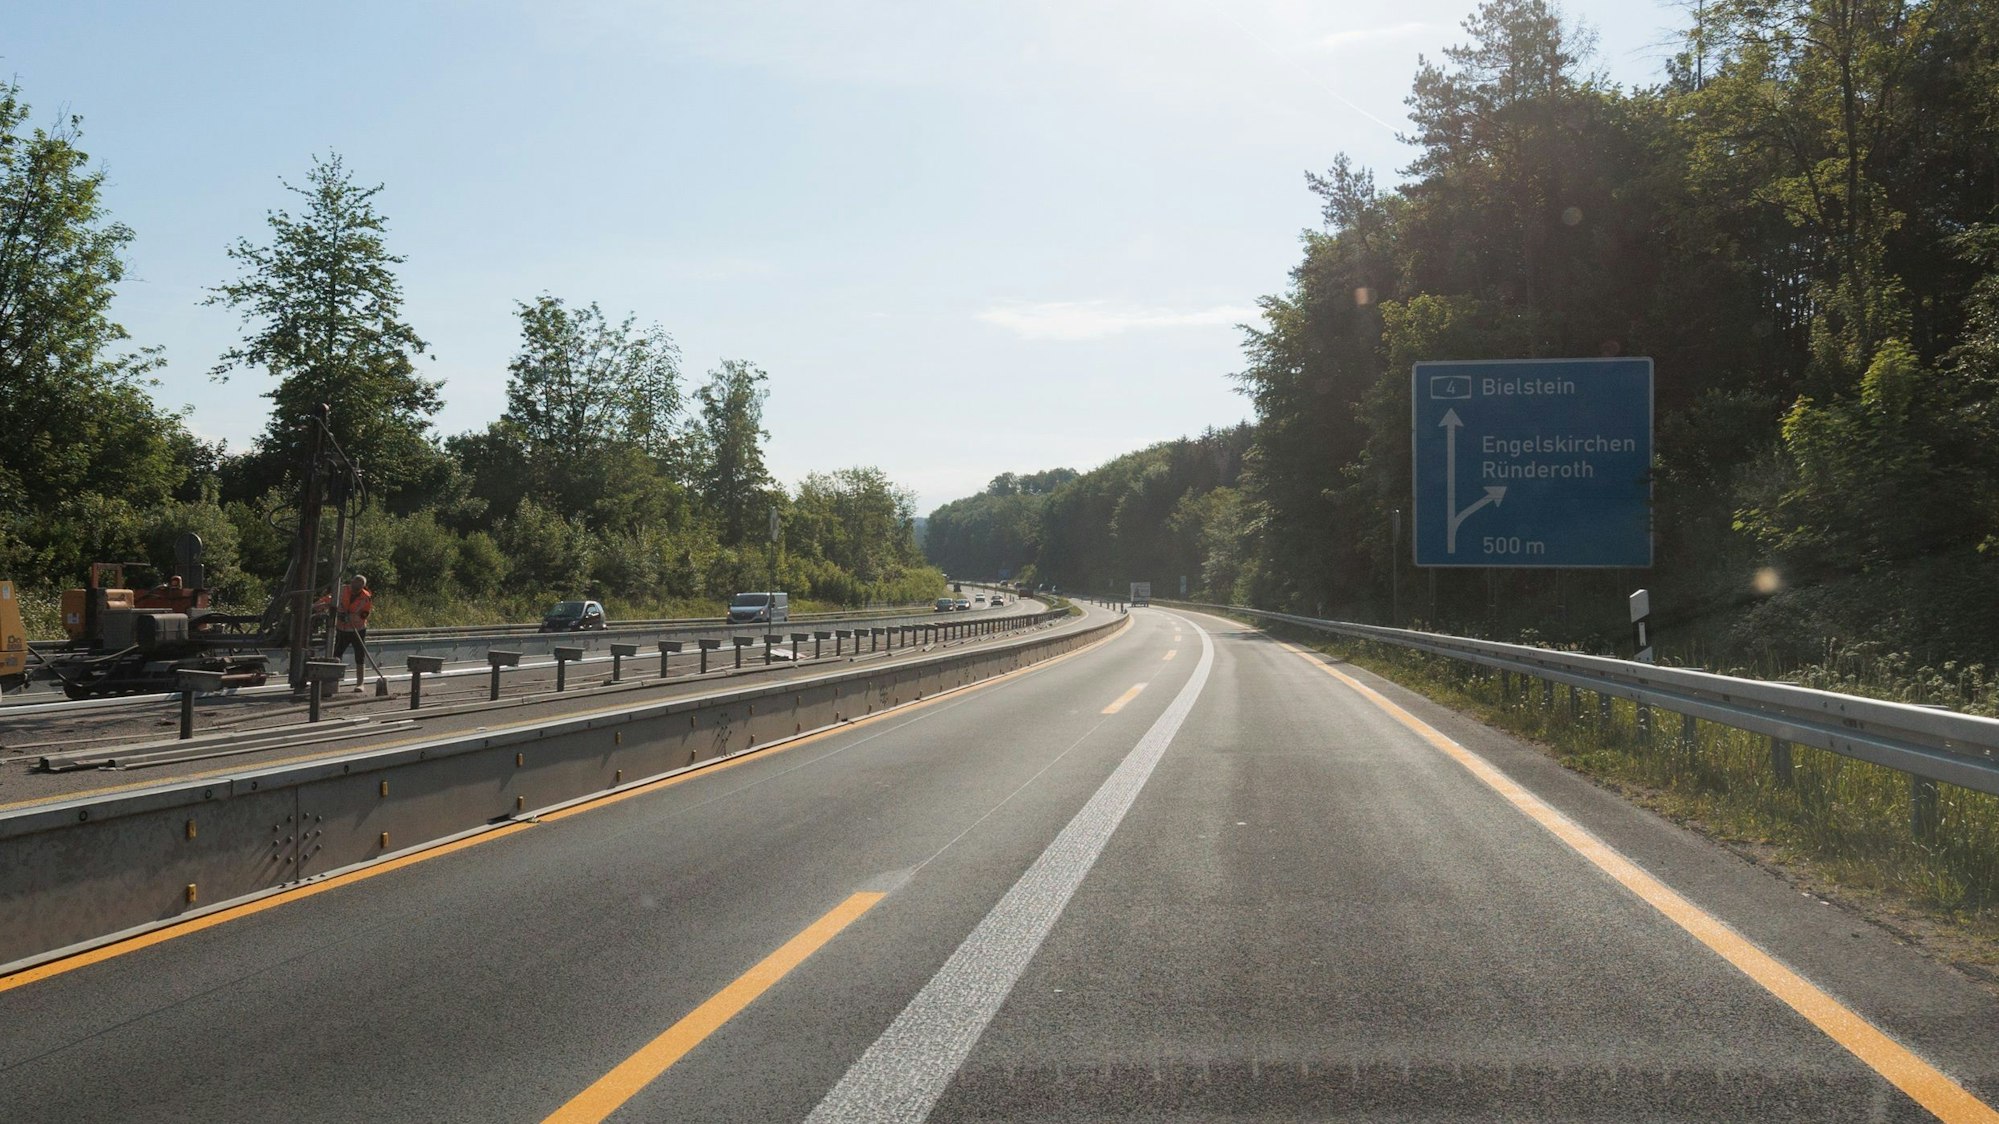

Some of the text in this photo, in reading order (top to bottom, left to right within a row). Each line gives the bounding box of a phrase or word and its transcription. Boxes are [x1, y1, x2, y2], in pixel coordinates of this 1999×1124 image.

[1446, 380, 1456, 394] 4
[1482, 377, 1575, 395] Bielstein
[1482, 435, 1636, 458] Engelskirchen
[1482, 461, 1594, 478] Ründeroth
[1483, 537, 1545, 554] 500 m
